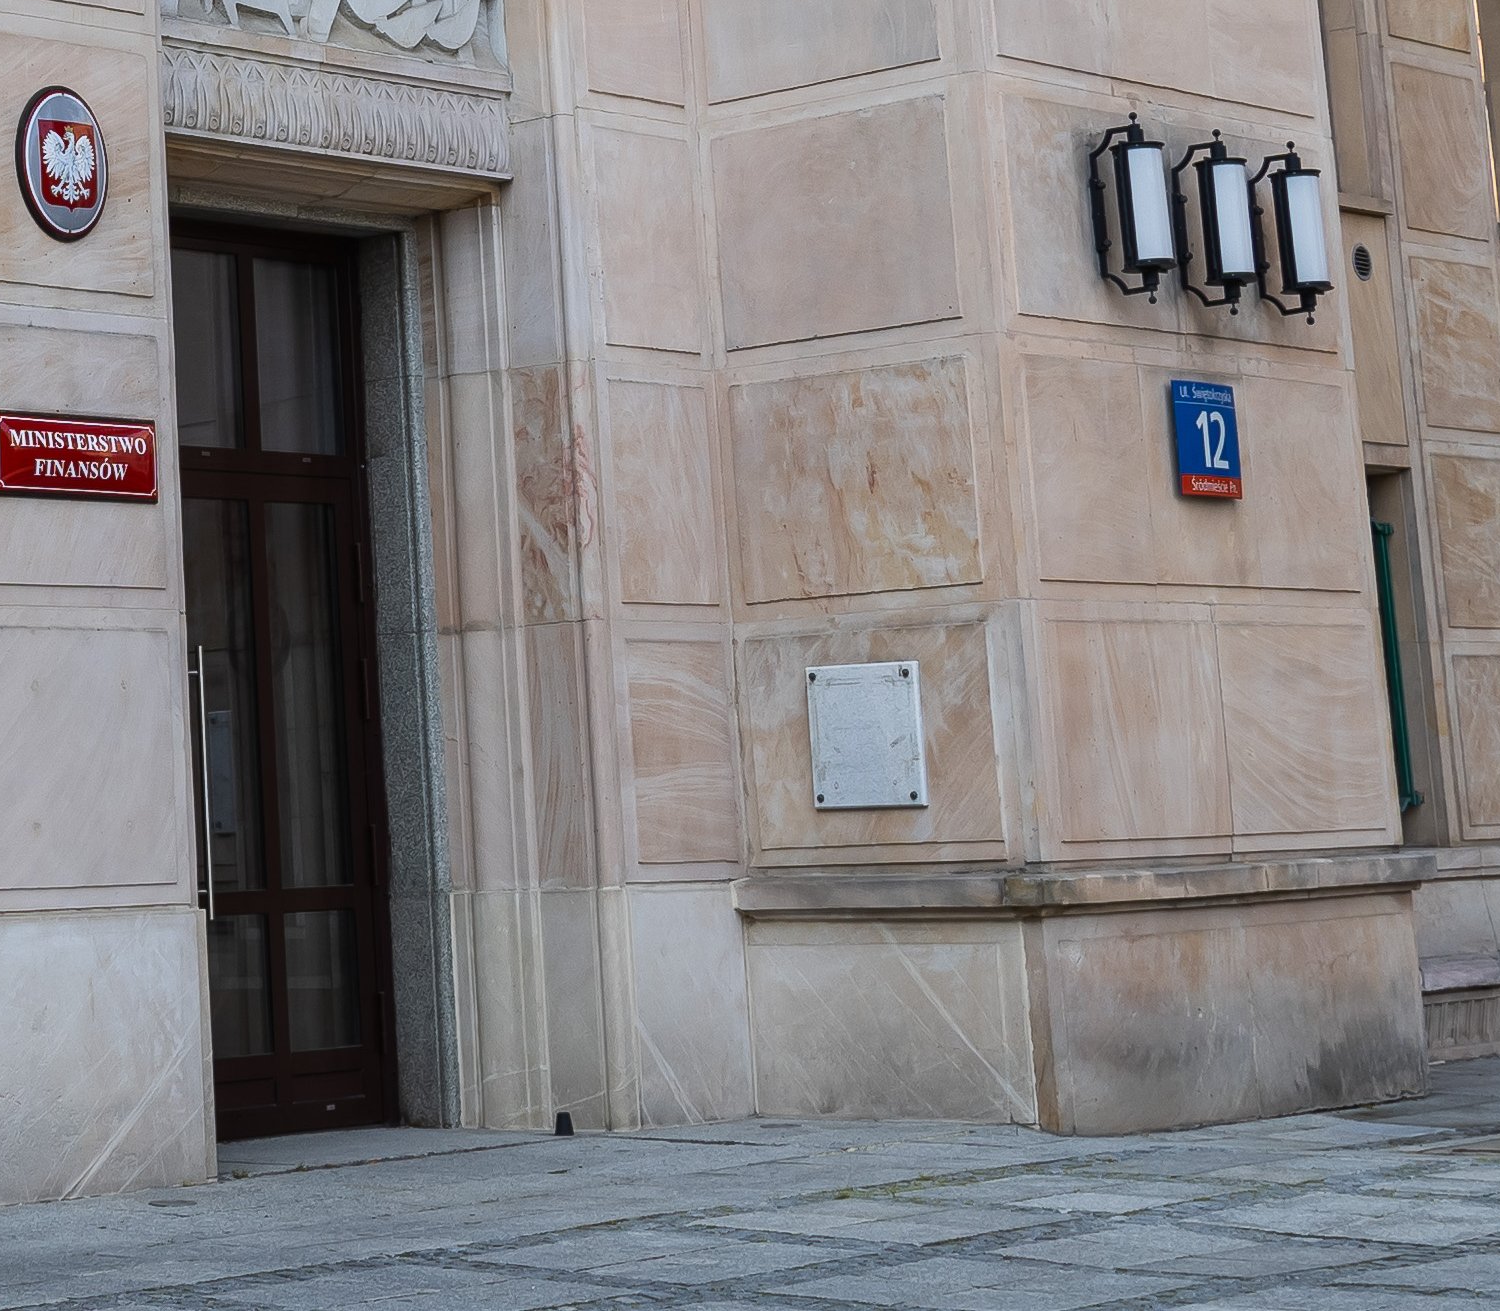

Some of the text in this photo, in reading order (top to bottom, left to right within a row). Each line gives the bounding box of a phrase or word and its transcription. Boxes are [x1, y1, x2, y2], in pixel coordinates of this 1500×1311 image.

[8, 428, 148, 456] MINISTERSTWO
[1195, 410, 1230, 470] 12
[33, 457, 129, 481] FINANSÓW
